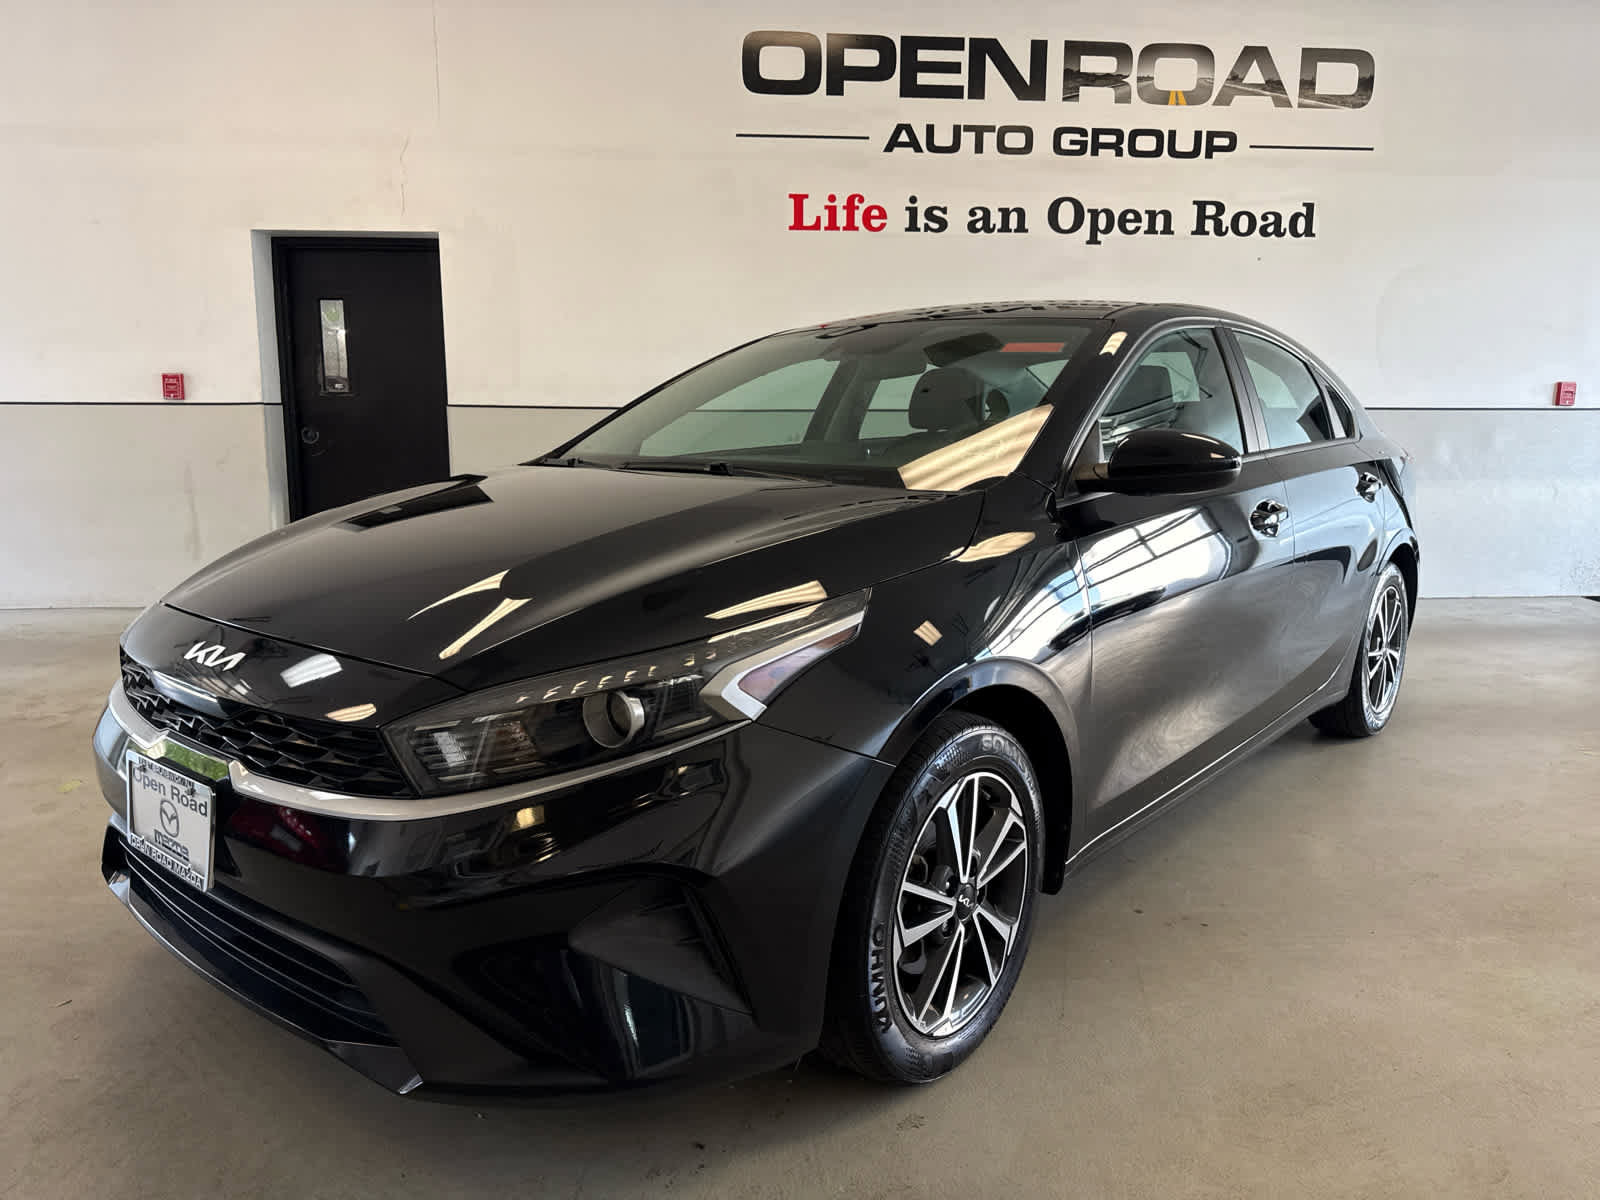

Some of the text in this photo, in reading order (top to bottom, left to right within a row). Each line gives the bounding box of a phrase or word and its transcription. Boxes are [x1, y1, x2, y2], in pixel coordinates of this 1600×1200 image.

[741, 30, 1376, 110] OPEN ROAD
[882, 122, 1238, 160] AUTO GROUP
[788, 192, 1316, 246] Life is an Open Road
[132, 766, 167, 797] Open
[170, 784, 208, 817] Road
